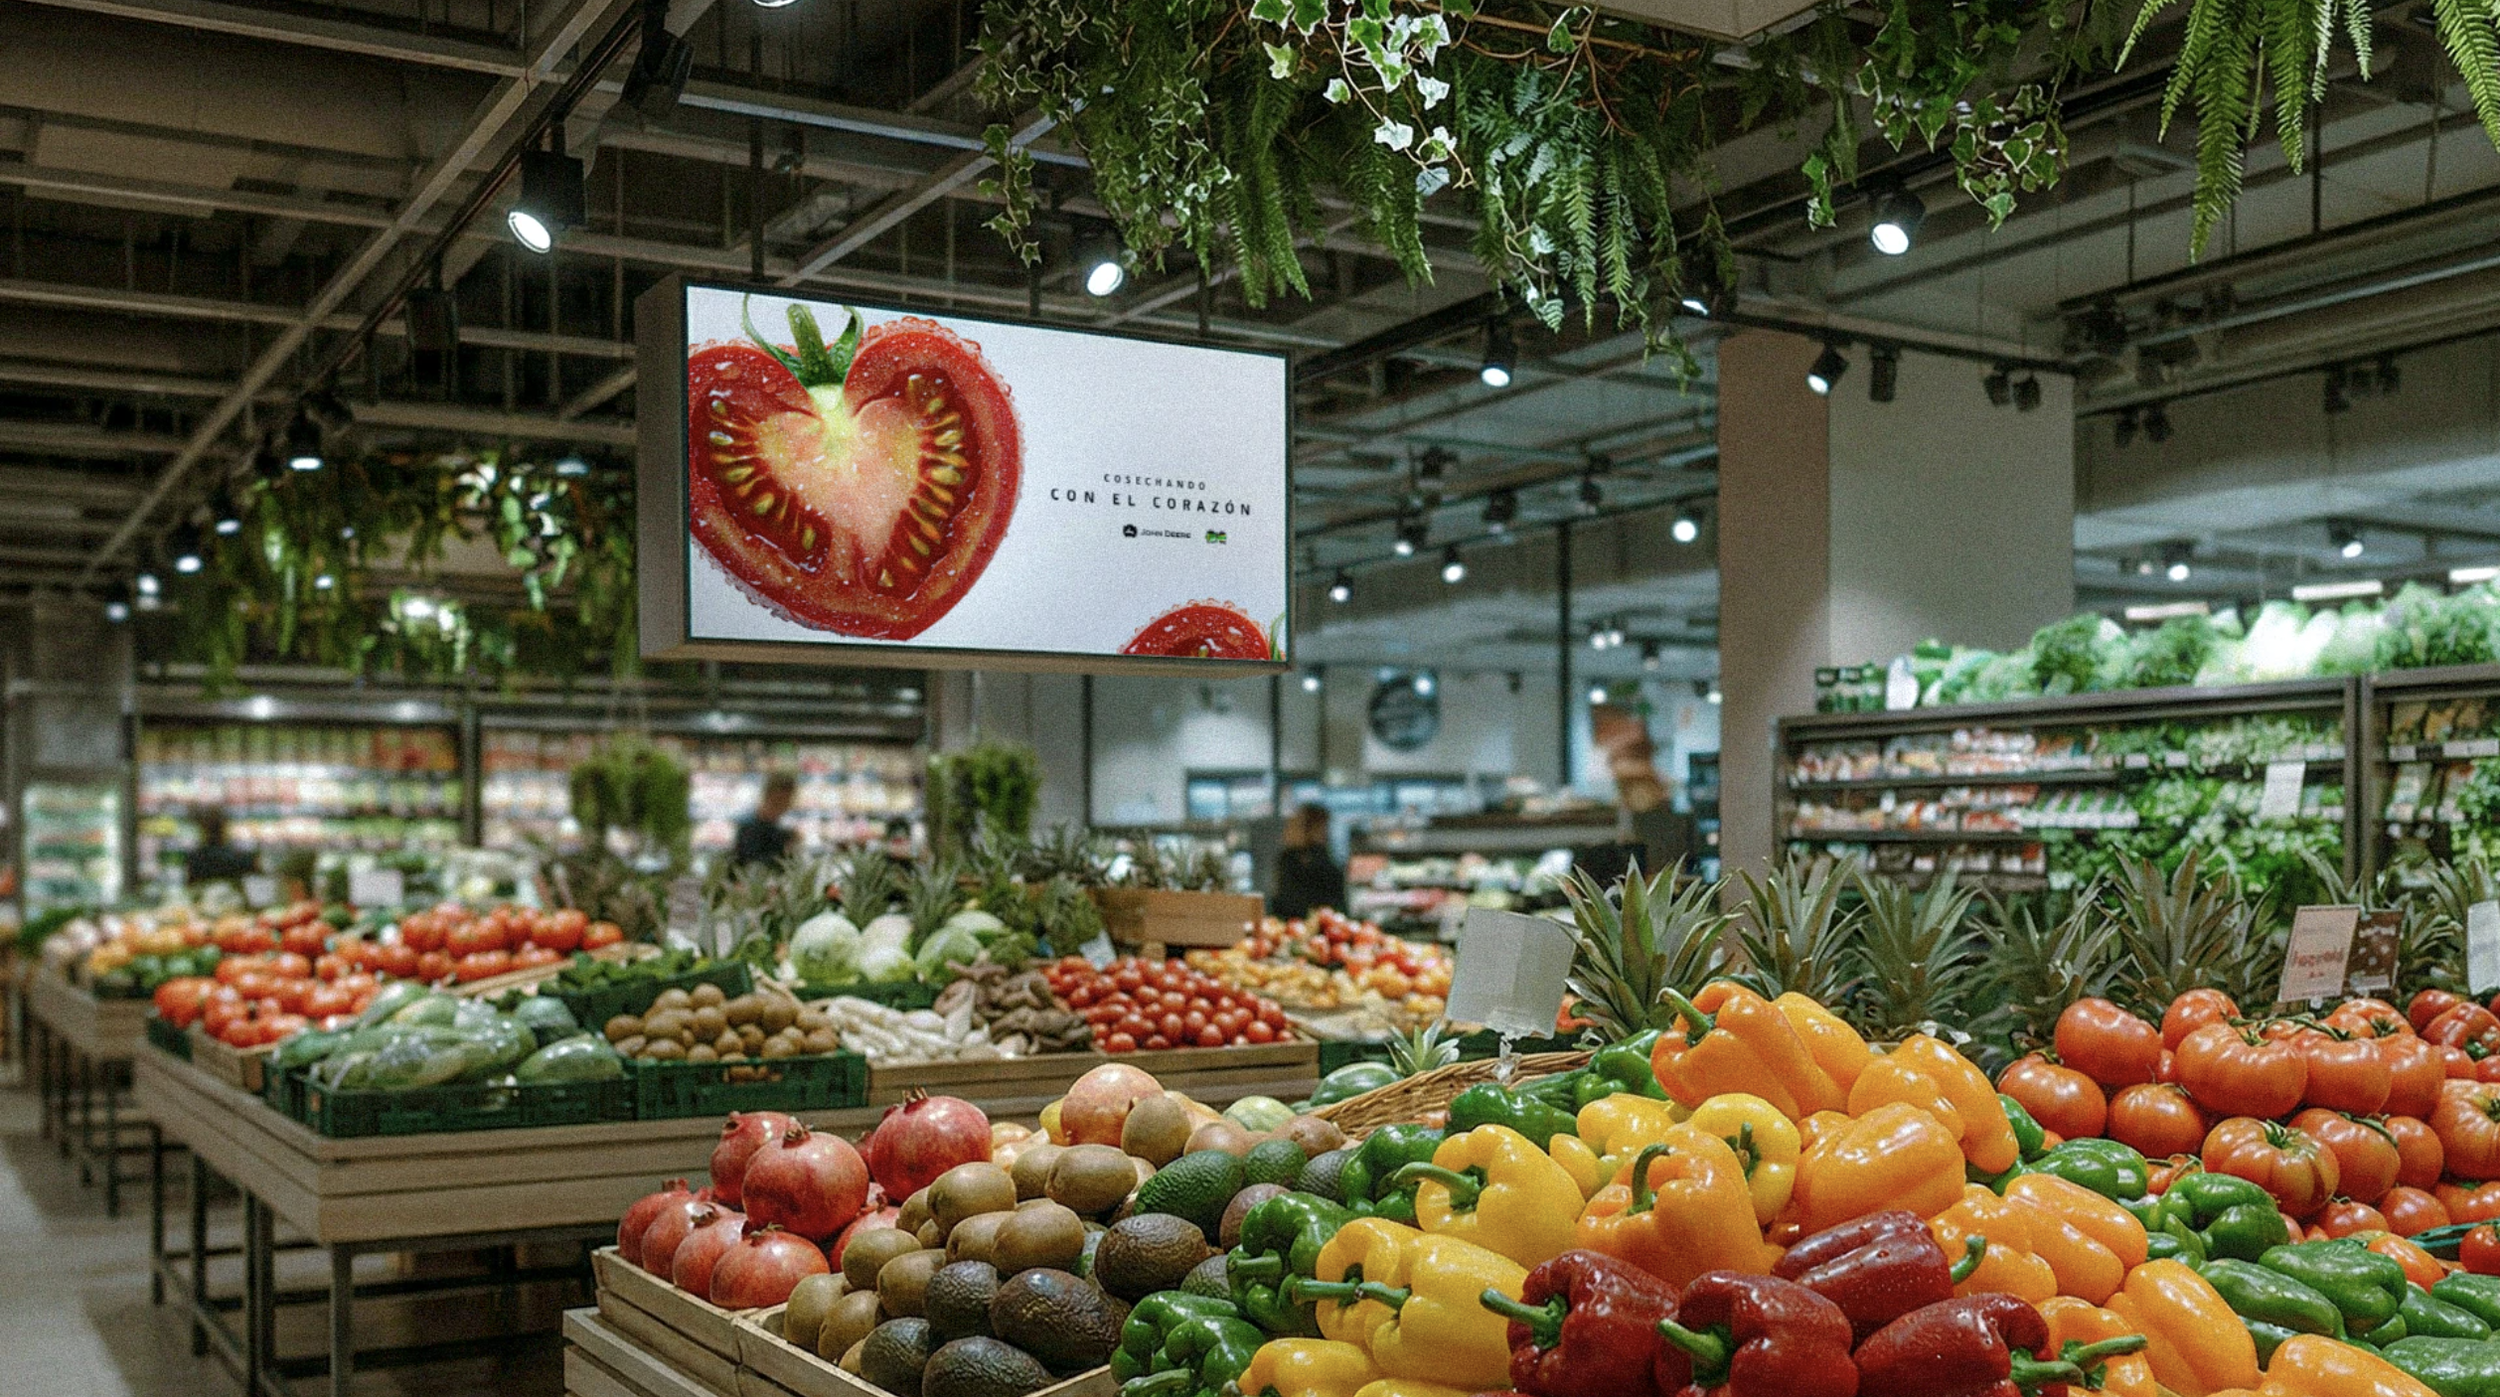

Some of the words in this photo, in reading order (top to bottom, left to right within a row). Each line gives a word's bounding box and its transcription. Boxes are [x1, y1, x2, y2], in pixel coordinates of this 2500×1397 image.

[1103, 473, 1206, 491] COSECHANDO
[1050, 488, 1095, 503] CON
[1112, 493, 1136, 507] EL
[1152, 496, 1251, 516] CORAZÓN
